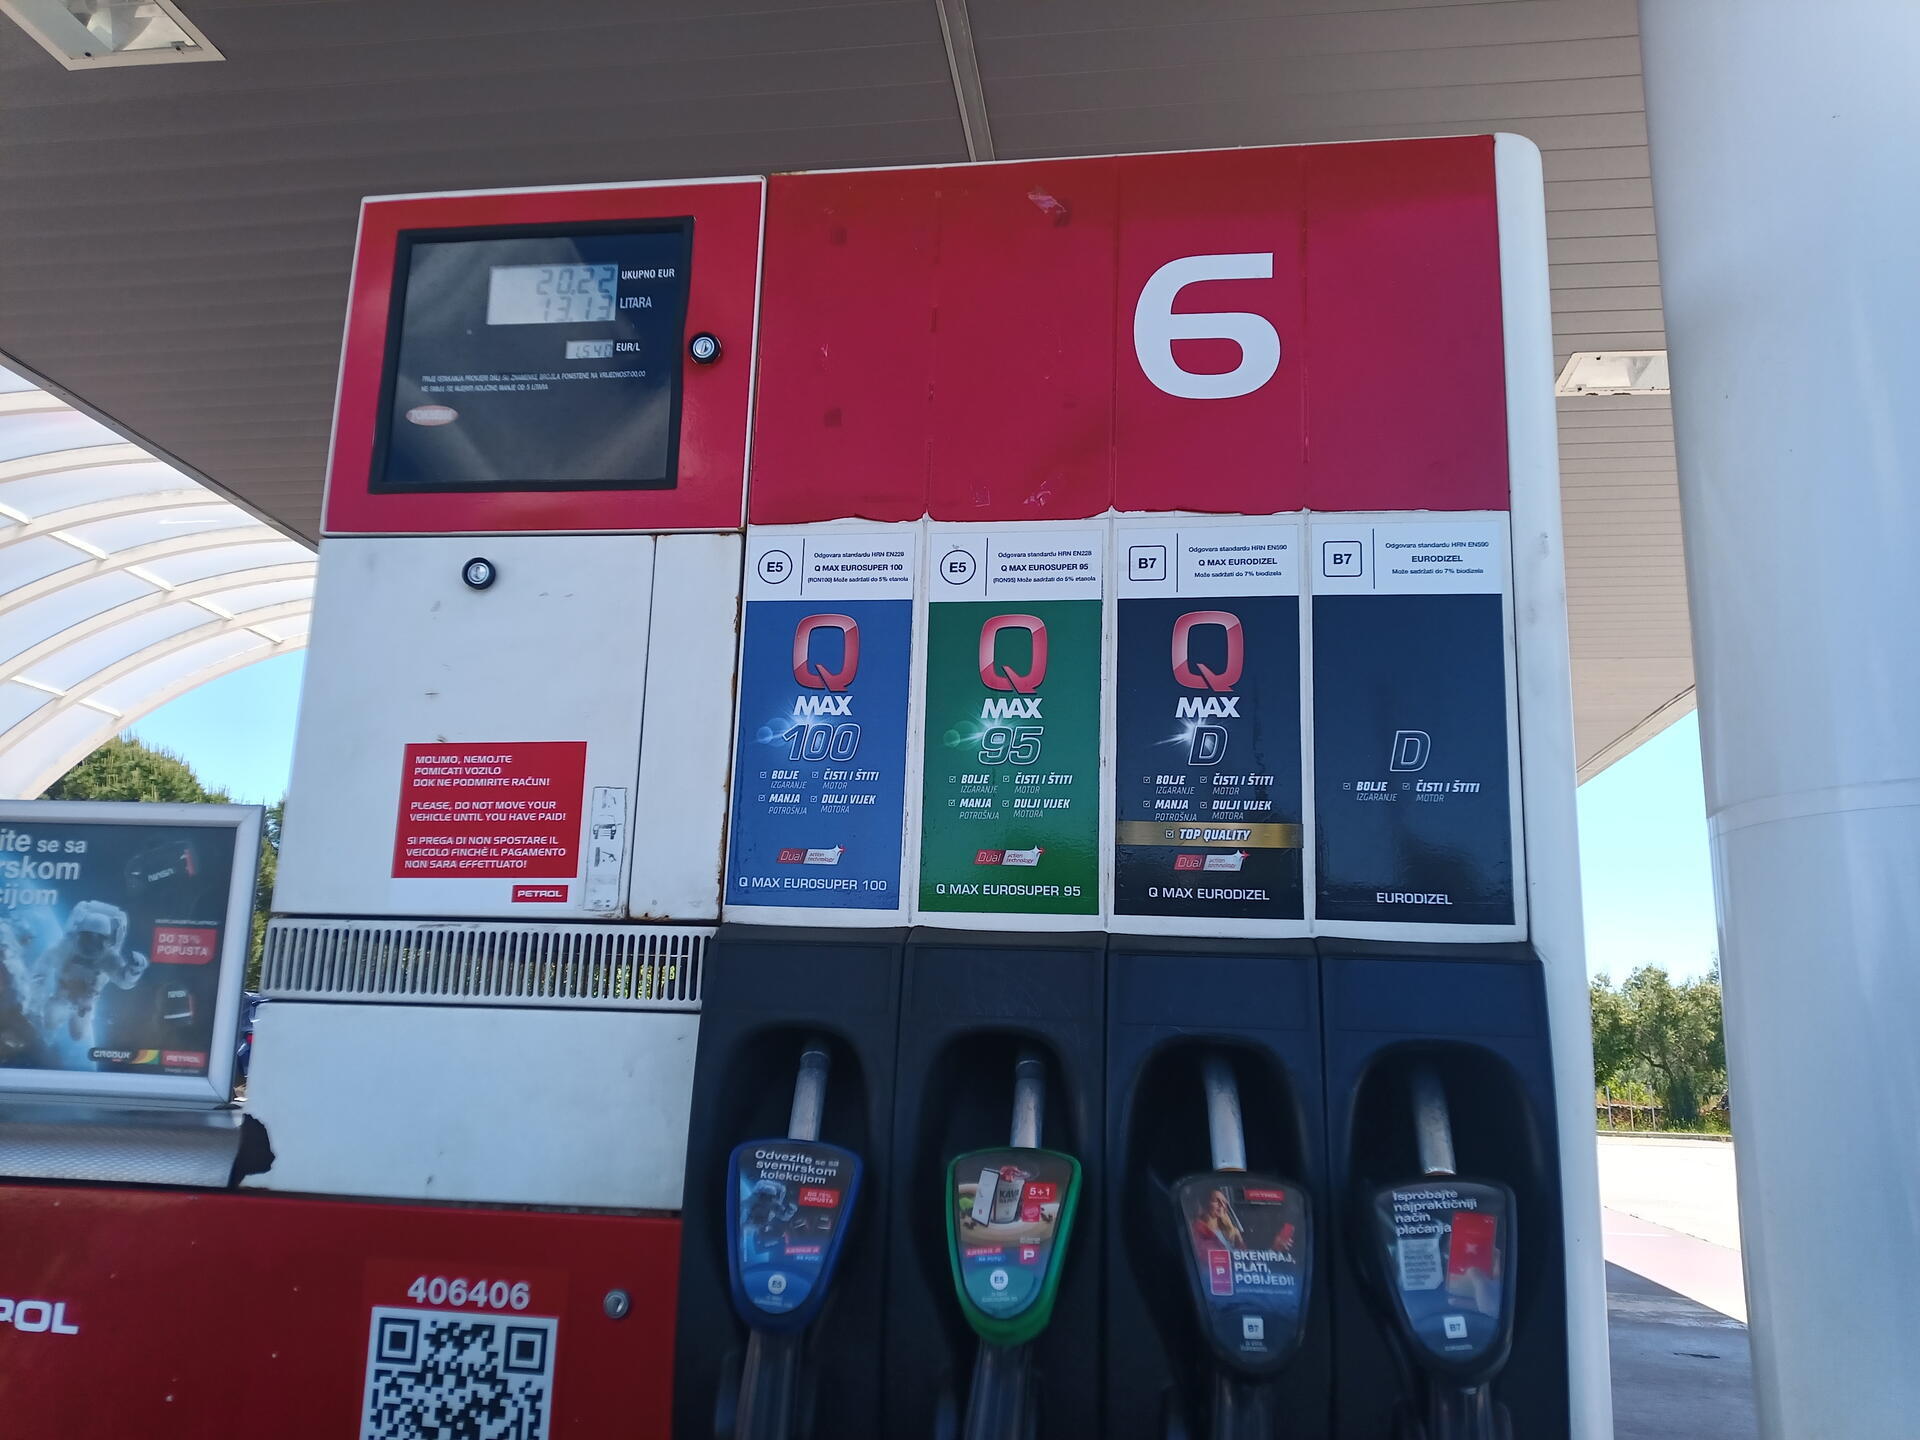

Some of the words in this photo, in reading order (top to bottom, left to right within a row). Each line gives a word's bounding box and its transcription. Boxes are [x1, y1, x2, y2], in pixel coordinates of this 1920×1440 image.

[621, 270, 656, 280] UKUPNO
[658, 269, 675, 278] EUR
[620, 297, 652, 308] LITARA
[1134, 253, 1281, 399] 6
[616, 343, 640, 351] EUR/L
[1139, 558, 1156, 568] B7
[1333, 554, 1352, 564] B7
[767, 562, 783, 572] E5
[950, 562, 966, 572] E5
[793, 613, 859, 692] Q
[979, 614, 1048, 694] Q
[1171, 610, 1244, 692] Q
[793, 696, 853, 716] MAX
[980, 698, 1043, 718] MAX
[1175, 697, 1240, 718] MAX
[783, 723, 860, 761] 100
[978, 726, 1043, 765] 95
[1188, 725, 1228, 765] D
[1390, 730, 1431, 771] D
[416, 756, 460, 764] MOLIMO,
[415, 767, 462, 775] POMICATI
[772, 770, 799, 779] BOLJE
[824, 768, 847, 780] ČISTI
[849, 772, 853, 780] I
[855, 769, 879, 780] ŠTITI
[453, 778, 510, 786] PODMIRITE
[511, 777, 550, 785] RAČUN!
[961, 775, 989, 783] BOLJE
[1015, 772, 1039, 784] ČISTI
[1042, 775, 1045, 784] I
[1048, 772, 1072, 784] ŠTITI
[1156, 775, 1185, 784] BOLJE
[1213, 773, 1238, 785] ČISTI
[1241, 776, 1245, 785] I
[1248, 773, 1274, 785] ŠTITI
[1213, 787, 1239, 795] MOTOR
[1356, 782, 1388, 791] BOLJE
[1416, 780, 1443, 792] ČISTI
[1446, 783, 1449, 792] I
[1452, 780, 1480, 793] ŠTITI
[769, 794, 800, 803] MANJA
[821, 795, 847, 803] DULJI
[850, 795, 876, 804] VIJEK
[960, 799, 991, 808] MANJA
[1014, 799, 1040, 808] DULJI
[1043, 799, 1070, 808] VIJEK
[411, 802, 451, 810] PLEASE,
[528, 801, 556, 809] YOUR
[821, 805, 850, 813] MOTORA
[1155, 800, 1188, 809] MANJA
[1212, 801, 1240, 810] DULJI
[1243, 801, 1272, 810] VIJEK
[486, 813, 506, 821] YOU
[1212, 812, 1243, 820] MOTORA
[1180, 829, 1200, 839] TOP
[1203, 830, 1250, 841] QUALITY
[37, 840, 59, 852] se
[64, 840, 87, 853] sa
[501, 848, 566, 856] PAGAMENTO
[781, 851, 803, 860] Dual
[978, 852, 1001, 862] Dual
[459, 860, 527, 868] EFFETTUATO!
[1178, 858, 1202, 867] Dual
[739, 877, 748, 887] Q
[752, 878, 780, 888] MAX
[784, 879, 857, 889] EUROSUPER
[863, 880, 886, 890] 100
[937, 884, 945, 895] Q
[950, 885, 978, 895] MAX
[983, 885, 1059, 896] EUROSUPER
[1064, 886, 1081, 896] 95
[1149, 888, 1158, 897] Q
[1162, 888, 1193, 898] MAX
[1197, 889, 1270, 900] EURODIZEL
[1376, 893, 1452, 904] EURODIZEL
[755, 1151, 812, 1164] Odvezite
[756, 1161, 836, 1176] svemirskom
[760, 1170, 825, 1184] kolekcijom
[1393, 1191, 1458, 1201] Isprobajte
[1394, 1199, 1477, 1211] najpraktičniji
[1395, 1213, 1431, 1222] način
[1233, 1251, 1296, 1264] SKENIRAJ,
[1234, 1262, 1271, 1274] PLATI,
[995, 1276, 1004, 1284] E5
[408, 1277, 529, 1310] 406406
